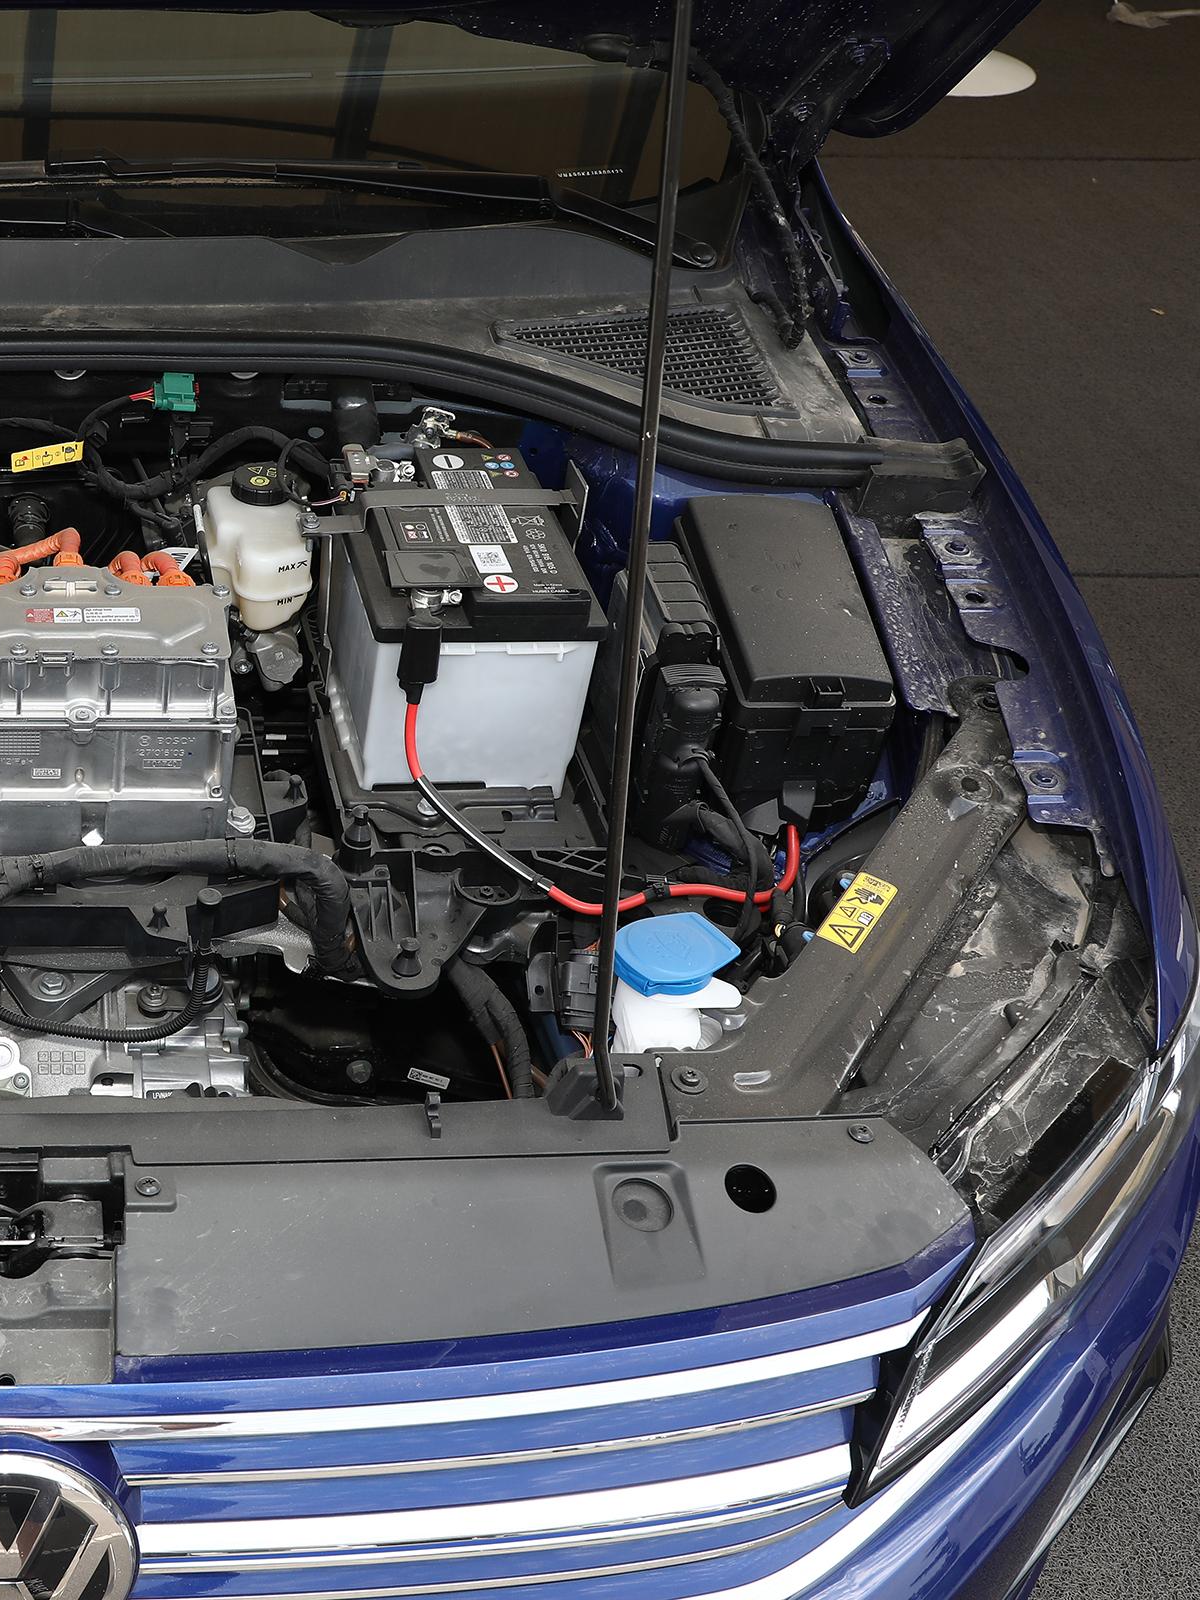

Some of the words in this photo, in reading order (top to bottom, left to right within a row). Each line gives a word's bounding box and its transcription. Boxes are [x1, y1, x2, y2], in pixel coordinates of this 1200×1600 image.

[278, 563, 296, 573] MAX
[277, 597, 293, 606] MIN
[157, 736, 196, 745] BOSCH
